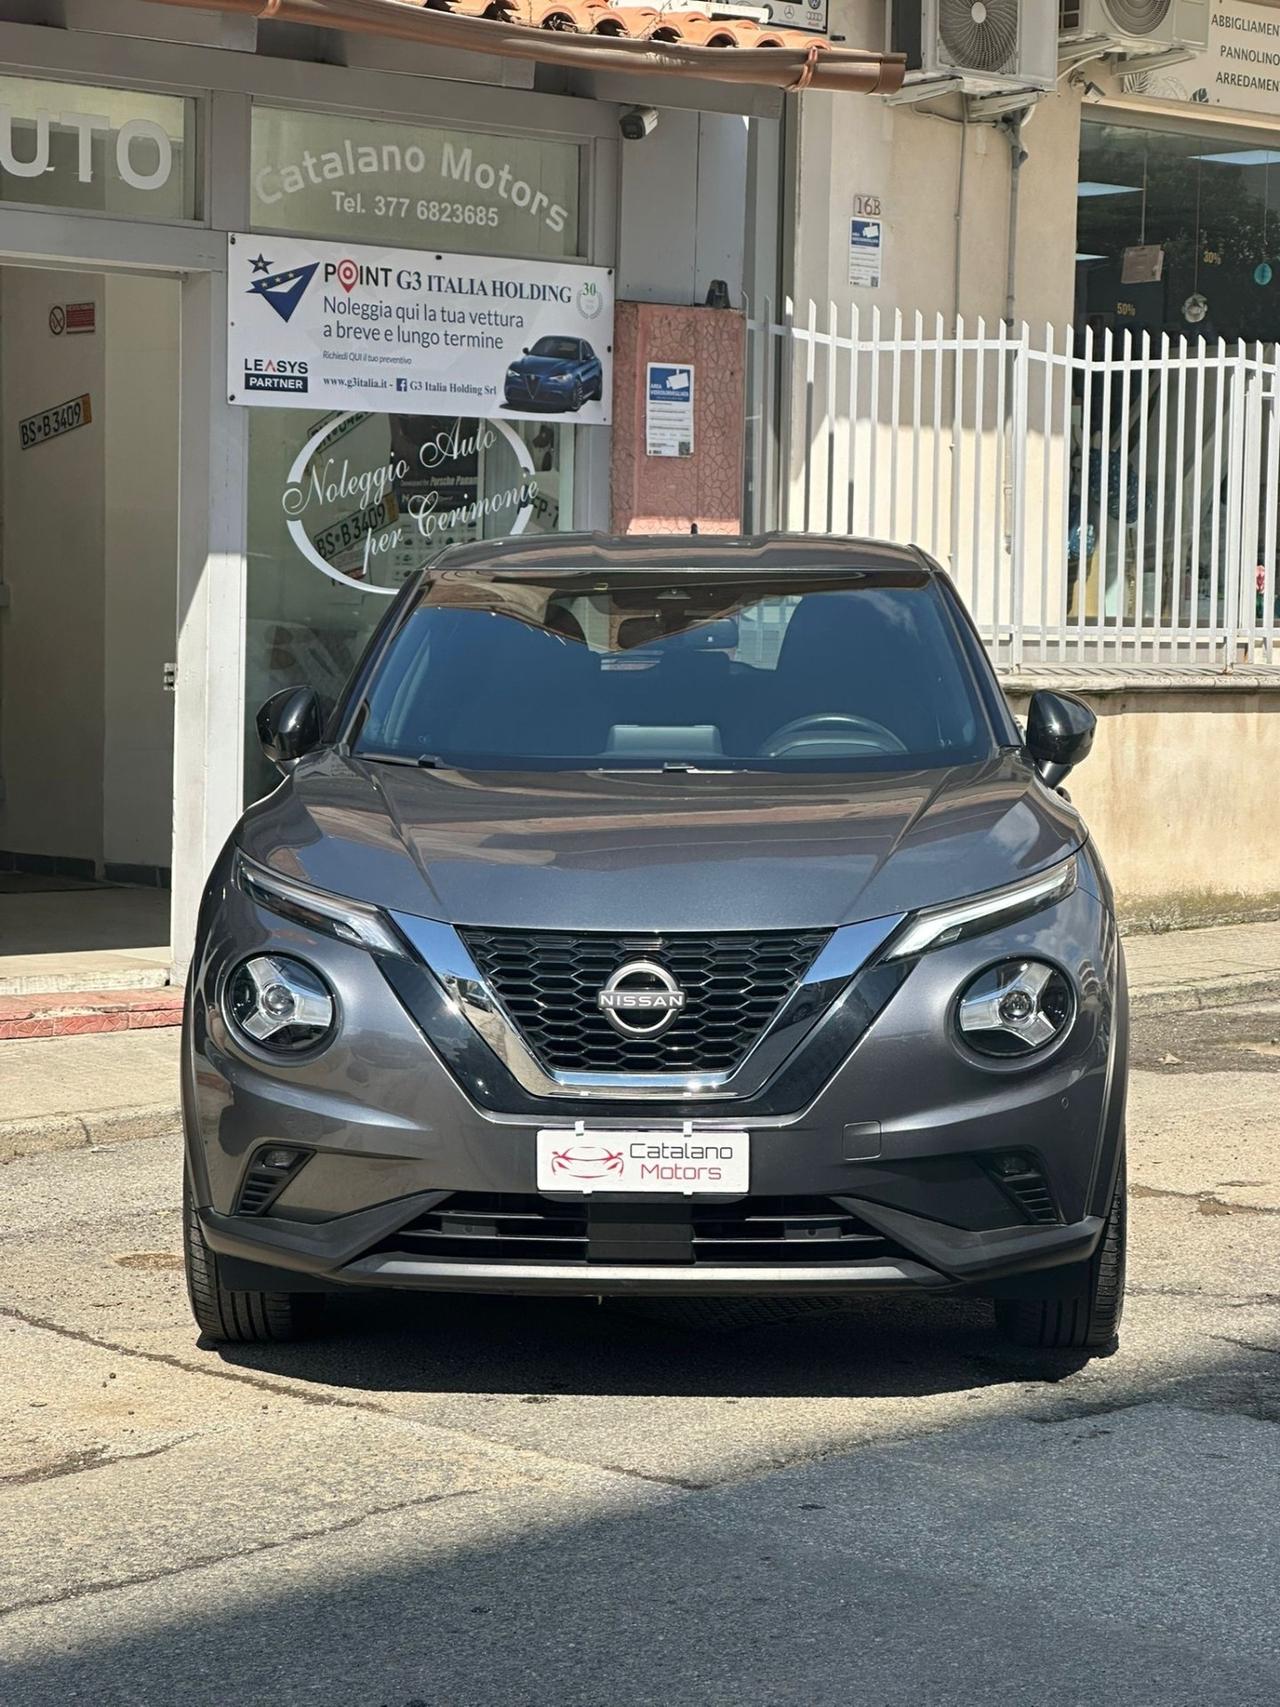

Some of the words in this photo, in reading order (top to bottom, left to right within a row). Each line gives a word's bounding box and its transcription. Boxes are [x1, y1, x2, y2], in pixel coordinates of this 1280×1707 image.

[1211, 14, 1280, 37] ABBIGLIAMEN
[1219, 44, 1280, 67] PANNOLINO
[1216, 71, 1280, 93] ARREDAMEN
[0, 103, 173, 191] UTO
[254, 138, 426, 206] Catalano
[440, 142, 570, 233] Motors
[332, 190, 366, 214] Tel.
[374, 195, 410, 219] 377
[416, 199, 500, 228] 6823685
[856, 196, 881, 216] 16B
[324, 259, 393, 293] POINT
[396, 269, 422, 291] G3
[427, 275, 486, 297] ITALIA
[490, 280, 573, 304] HOLDING
[582, 282, 597, 296] 30
[323, 296, 393, 320] Noleggia
[396, 305, 420, 324] qui
[423, 305, 437, 323] la
[440, 308, 466, 325] tua
[469, 310, 525, 328] vettura
[323, 326, 333, 338] a
[336, 324, 380, 341] breve
[384, 330, 393, 342] e
[397, 327, 441, 350] lungo
[444, 331, 504, 350] termine
[245, 357, 309, 375] LEASYS
[323, 350, 348, 361] Richiedi
[348, 352, 362, 362] QUI
[368, 355, 378, 363] tuo
[379, 355, 413, 365] preventivo
[249, 376, 304, 391] PARTNER
[323, 377, 388, 390] www.g3italia.it
[410, 380, 423, 391] G3
[425, 381, 448, 393] Italia
[449, 382, 483, 397] Holding
[484, 384, 498, 395] Srl
[282, 452, 410, 516] Noleggio
[419, 416, 498, 468] Auto
[363, 526, 404, 576] per
[407, 472, 540, 538] Cerimonie
[600, 993, 684, 1008] NISSAN
[629, 1141, 734, 1161] Catalano
[640, 1162, 723, 1181] Motors
